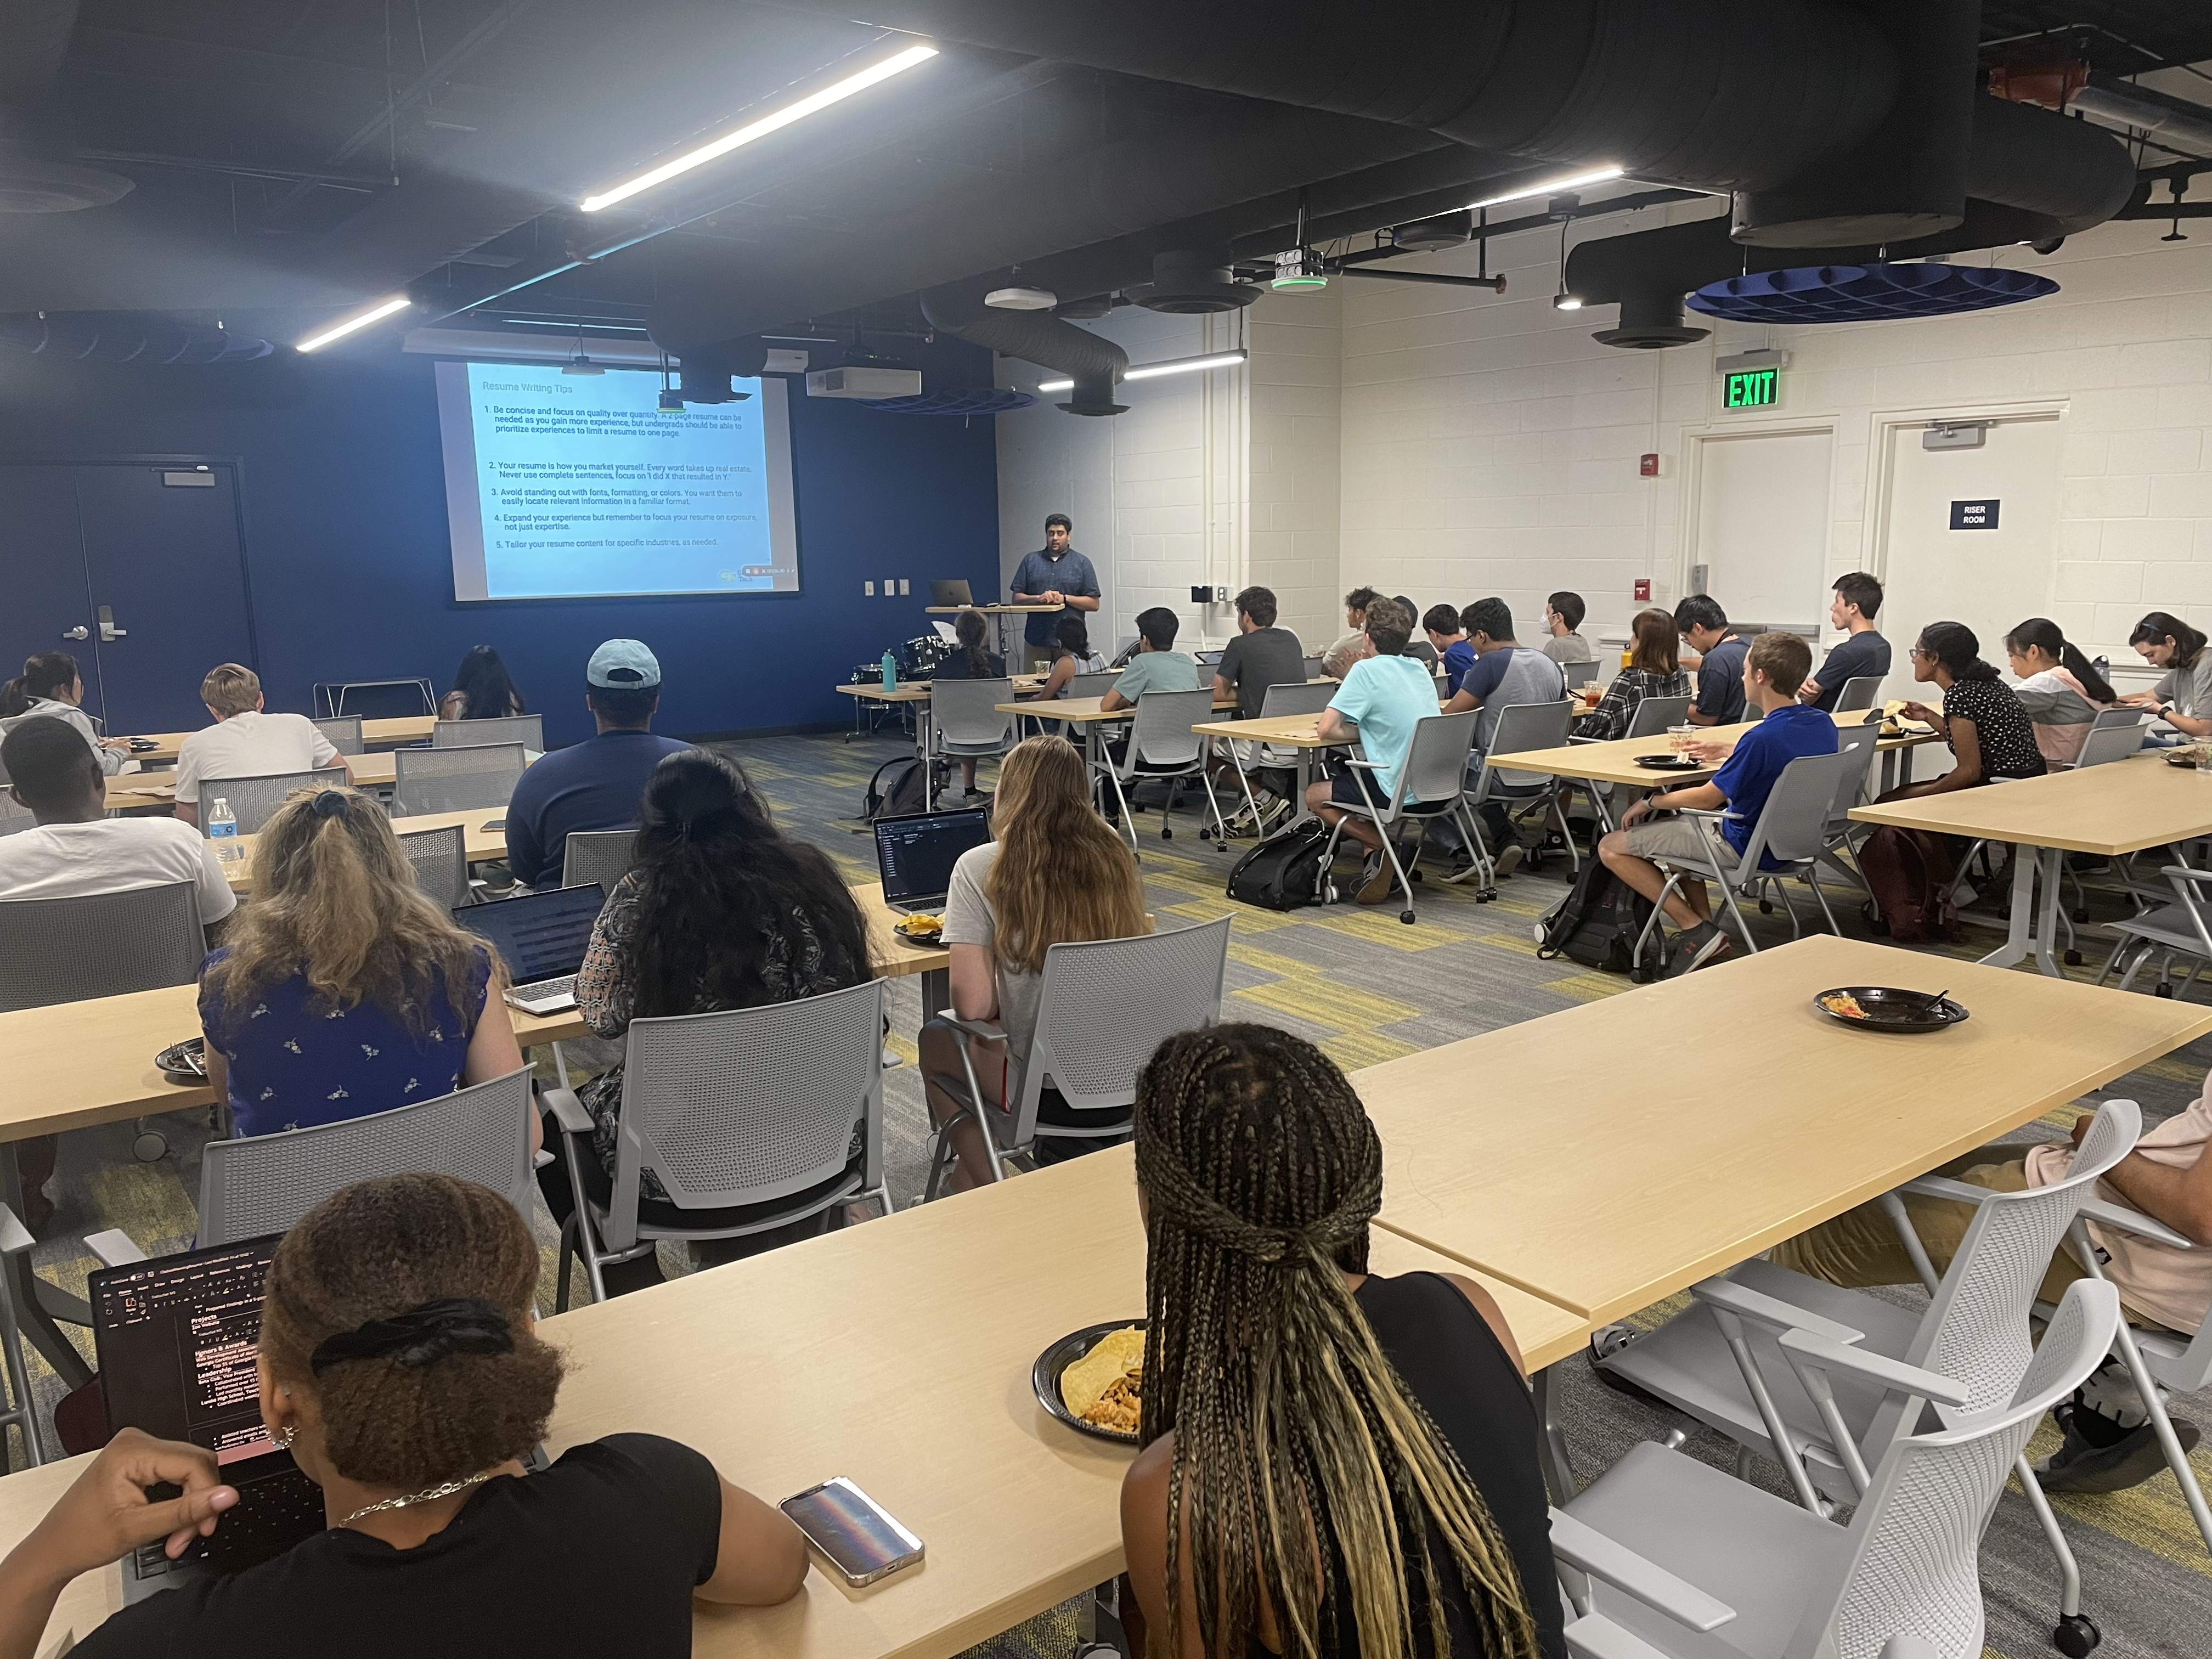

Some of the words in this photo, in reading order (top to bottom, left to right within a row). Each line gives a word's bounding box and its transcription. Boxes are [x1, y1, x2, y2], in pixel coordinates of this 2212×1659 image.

[483, 381, 519, 391] Resume
[521, 383, 552, 394] Writing
[554, 385, 573, 394] Tips
[1729, 372, 1774, 407] EXIT
[553, 408, 574, 416] focus
[586, 409, 611, 419] quality
[629, 411, 660, 421] quantity.
[551, 417, 567, 426] gain
[589, 419, 630, 427] experience,
[645, 421, 684, 429] undergrads
[495, 425, 529, 433] prioritize
[531, 426, 575, 434] experiences
[615, 463, 646, 472] yourself.
[647, 464, 666, 472] Every
[539, 471, 574, 479] complete
[616, 471, 635, 479] focus
[524, 489, 556, 497] standing
[611, 489, 649, 497] formatting,
[501, 498, 524, 506] easily
[1964, 506, 1986, 514] RISER
[503, 514, 532, 523] Expand
[518, 523, 533, 532] just
[617, 539, 644, 548] specific
[646, 539, 681, 547] industries,
[191, 1314, 217, 1324] Projects
[195, 1348, 218, 1358] Honors
[225, 1340, 247, 1350] Awards
[198, 1367, 232, 1379] Leadership
